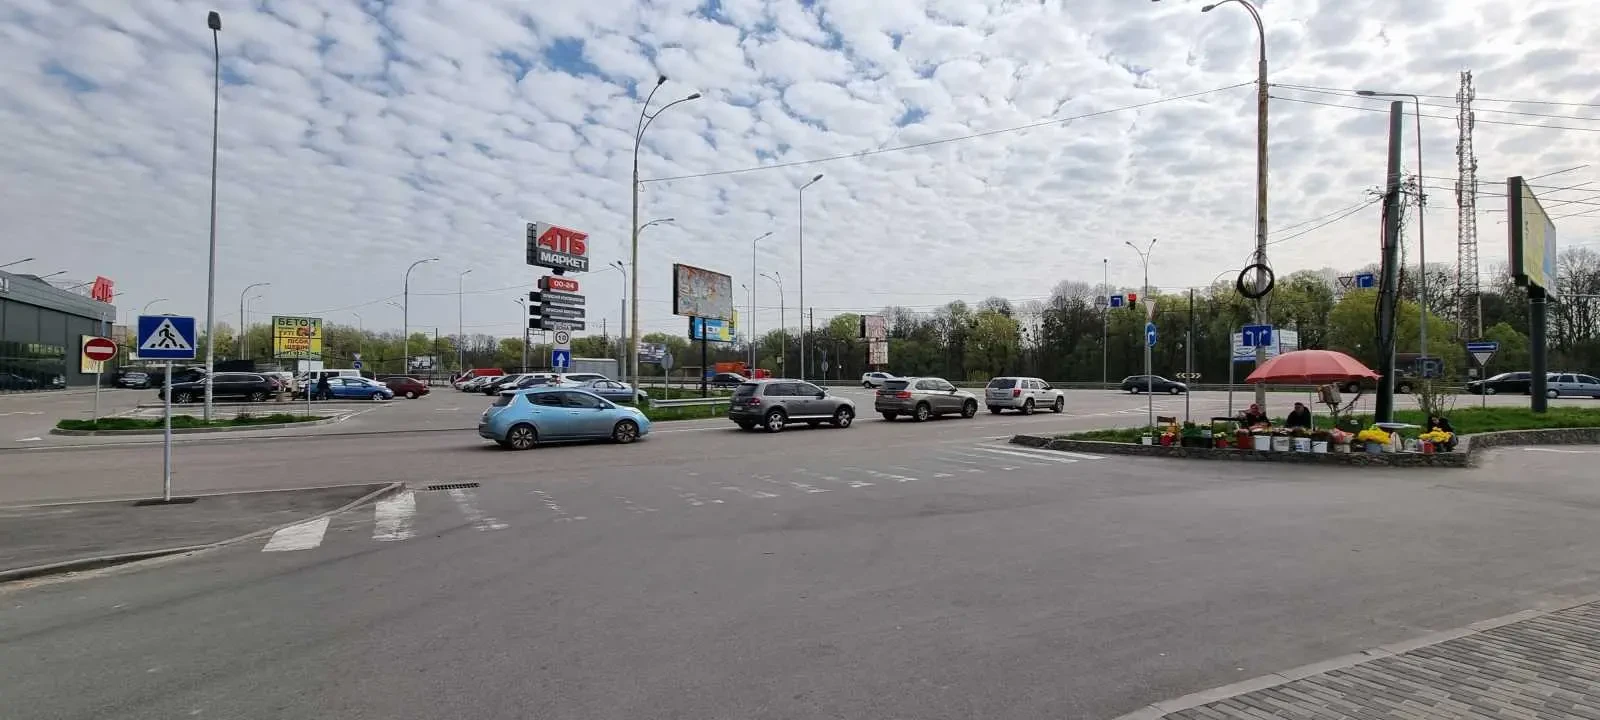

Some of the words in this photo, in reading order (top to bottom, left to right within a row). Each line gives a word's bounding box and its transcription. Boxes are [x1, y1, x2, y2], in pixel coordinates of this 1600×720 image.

[538, 226, 589, 256] АТБ
[540, 251, 587, 269] МАРКЕТ
[553, 280, 575, 289] 00-24
[278, 317, 316, 327] БЕТОН
